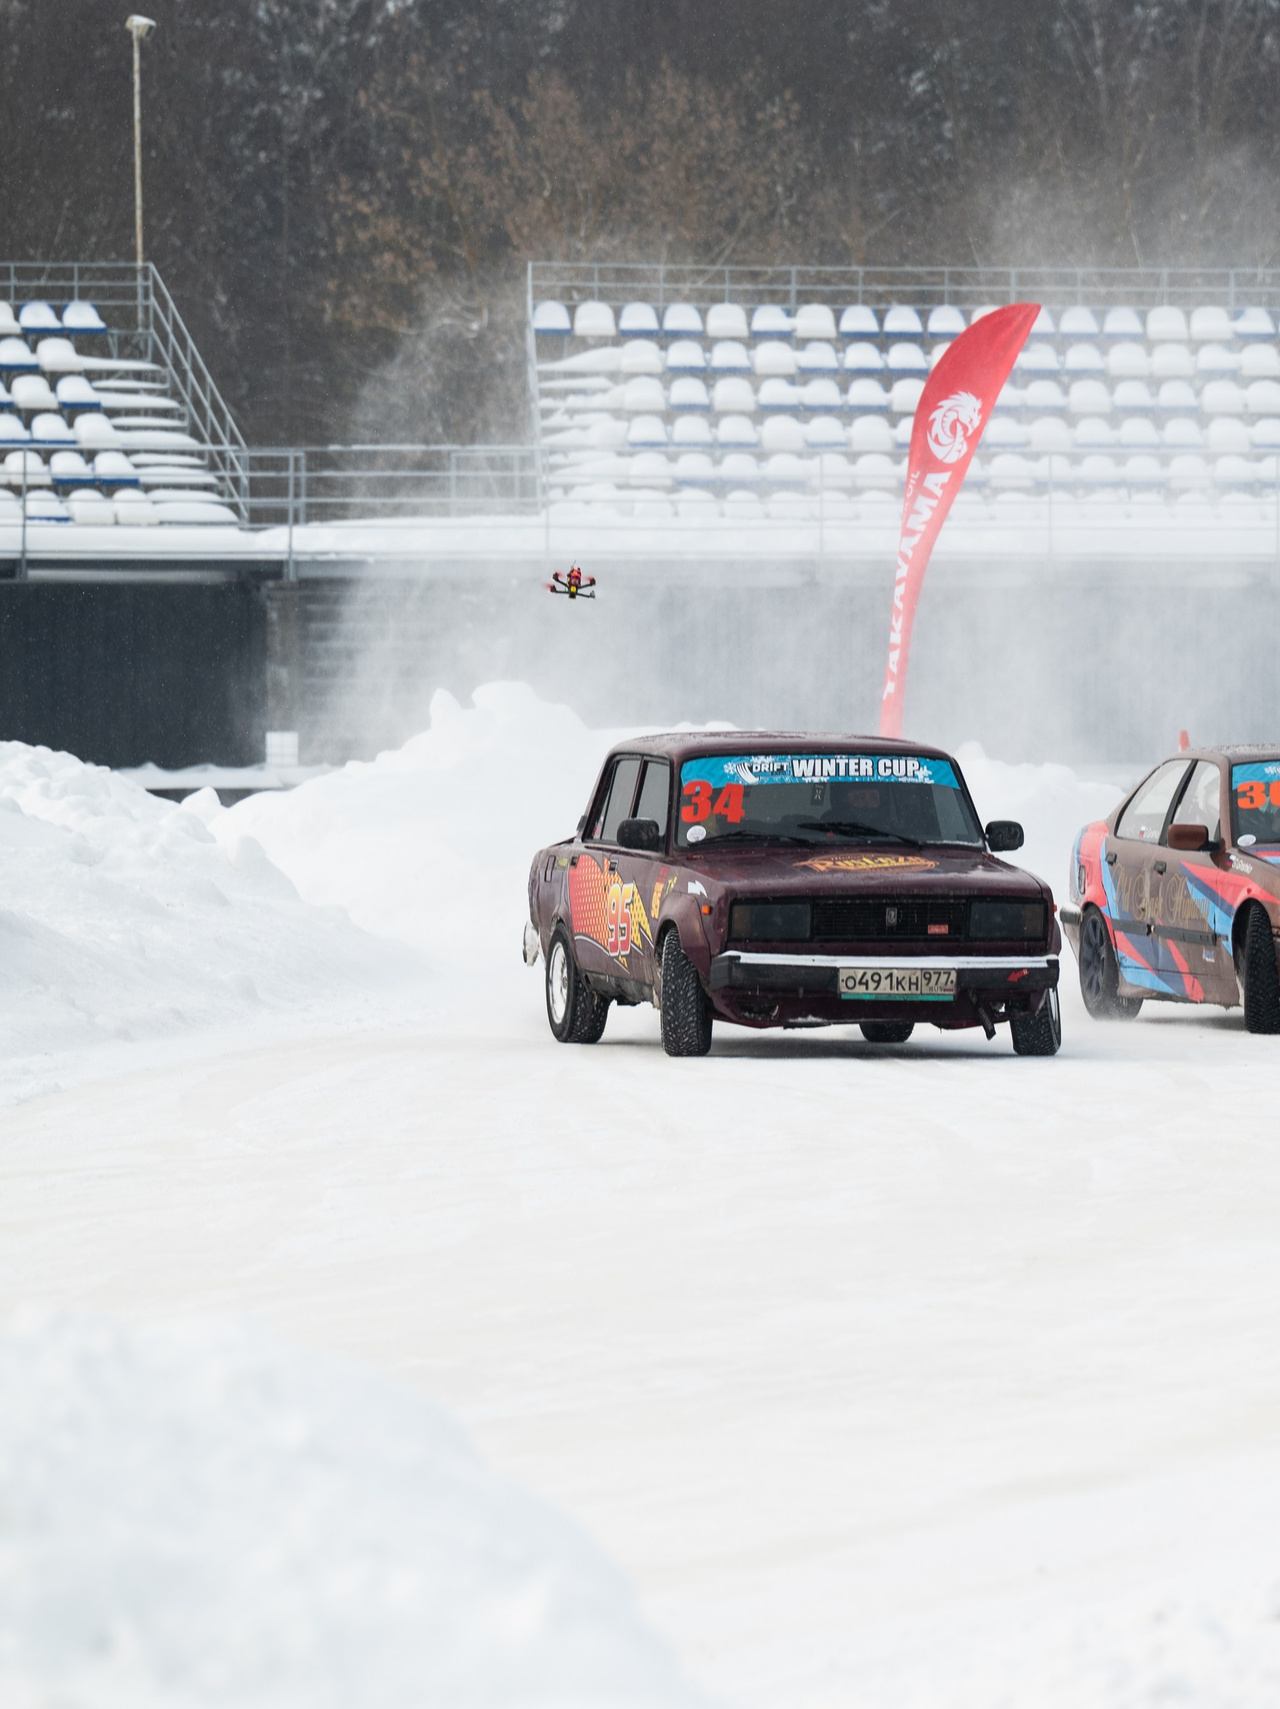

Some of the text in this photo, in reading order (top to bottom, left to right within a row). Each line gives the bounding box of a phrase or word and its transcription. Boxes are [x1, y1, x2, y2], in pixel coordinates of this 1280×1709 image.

[883, 471, 952, 700] TAKAYAMA
[752, 759, 920, 778] DRIFT WINTER CUP
[681, 780, 745, 823] 34
[607, 883, 634, 957] 95
[923, 972, 951, 986] 977
